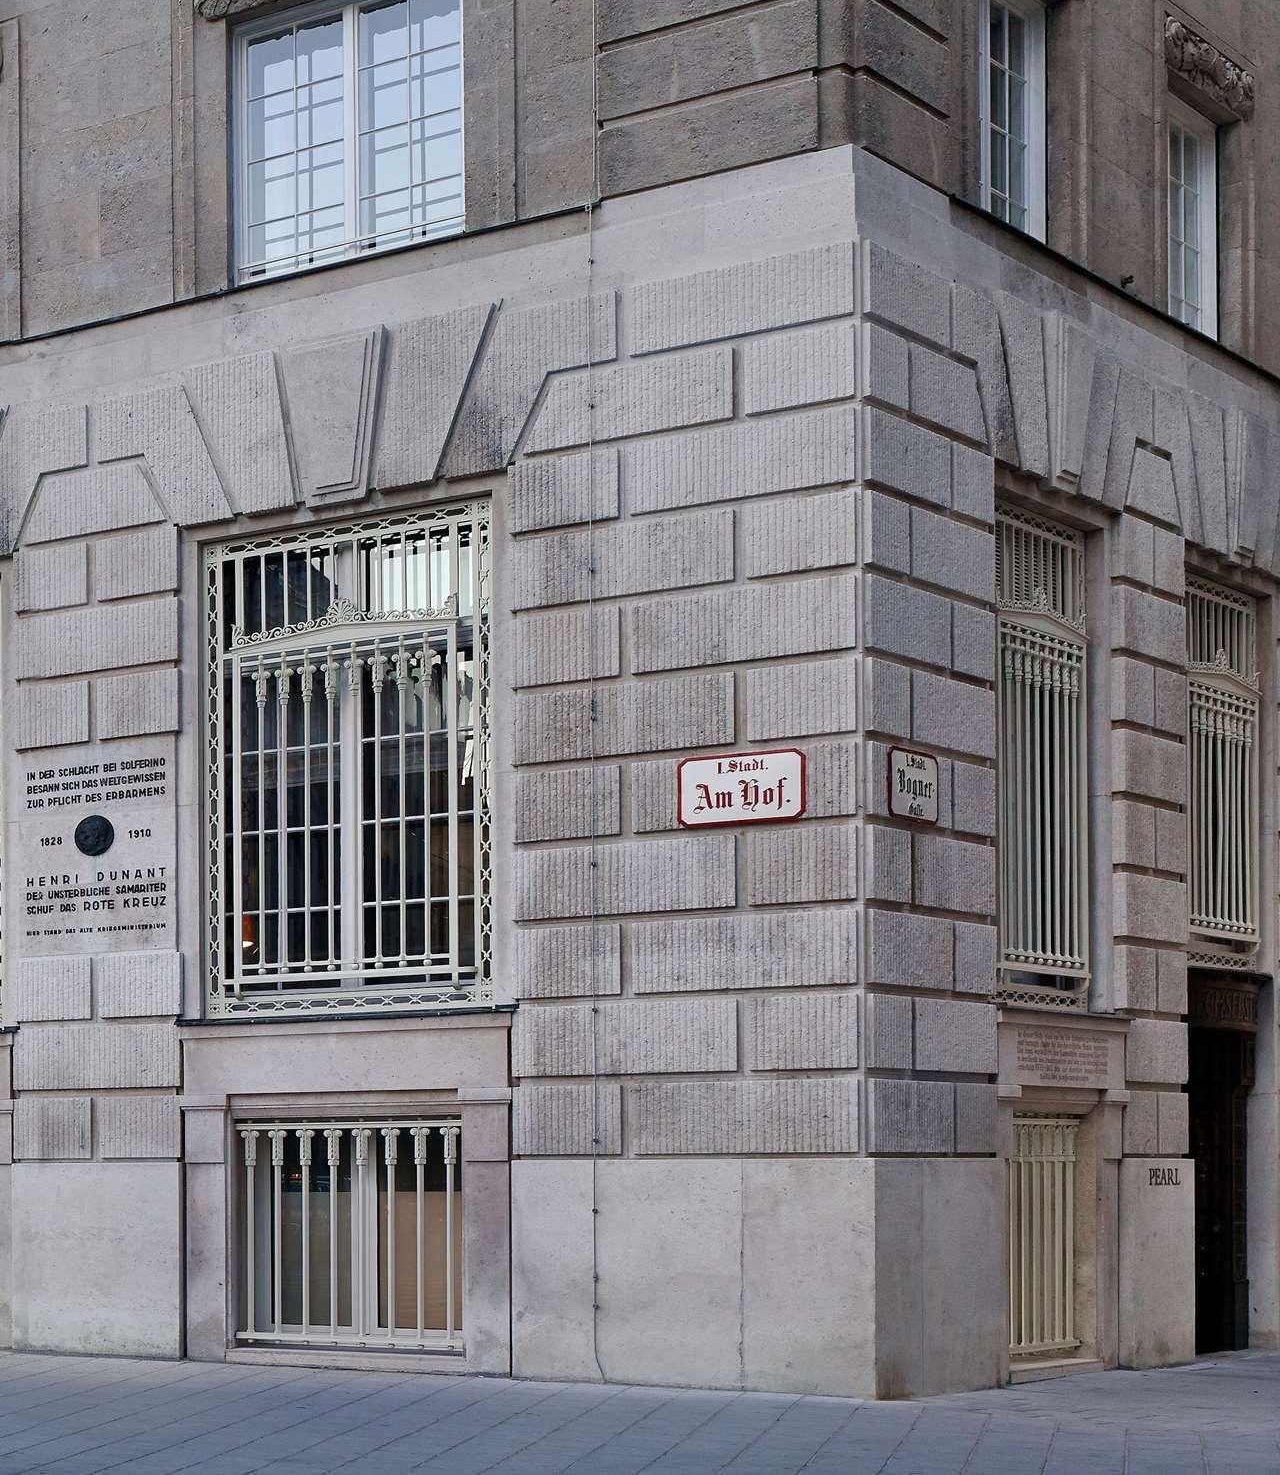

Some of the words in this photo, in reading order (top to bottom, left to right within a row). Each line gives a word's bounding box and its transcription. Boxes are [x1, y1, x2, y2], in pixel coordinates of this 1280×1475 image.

[27, 772, 36, 781] IN
[39, 770, 54, 780] DER
[58, 765, 99, 778] SCHLACHT
[103, 763, 117, 772] BEI
[121, 758, 166, 770] SOLFERINO
[27, 783, 60, 794] BESANN
[62, 780, 80, 791] SICH
[82, 779, 98, 788] DAS
[100, 772, 166, 786] WELTGEWISSEN
[27, 799, 44, 809] ZUR
[48, 794, 81, 807] PFLICHT
[85, 793, 102, 803] DES
[106, 786, 166, 801] ERBARMENS
[693, 783, 734, 814] Am
[738, 777, 791, 811] Hof.
[40, 836, 62, 847] 1828
[128, 828, 151, 838] 1910
[27, 874, 79, 887] HENRI
[97, 867, 166, 881] DUNANT
[48, 886, 110, 899] UNSTERBLICHE
[116, 883, 166, 894] SAMARITER
[27, 904, 54, 915] SCHUF
[60, 903, 76, 912] DAS
[84, 900, 115, 911] ROTE
[123, 896, 167, 908] KREUZ
[1149, 1168, 1181, 1186] PEARL
